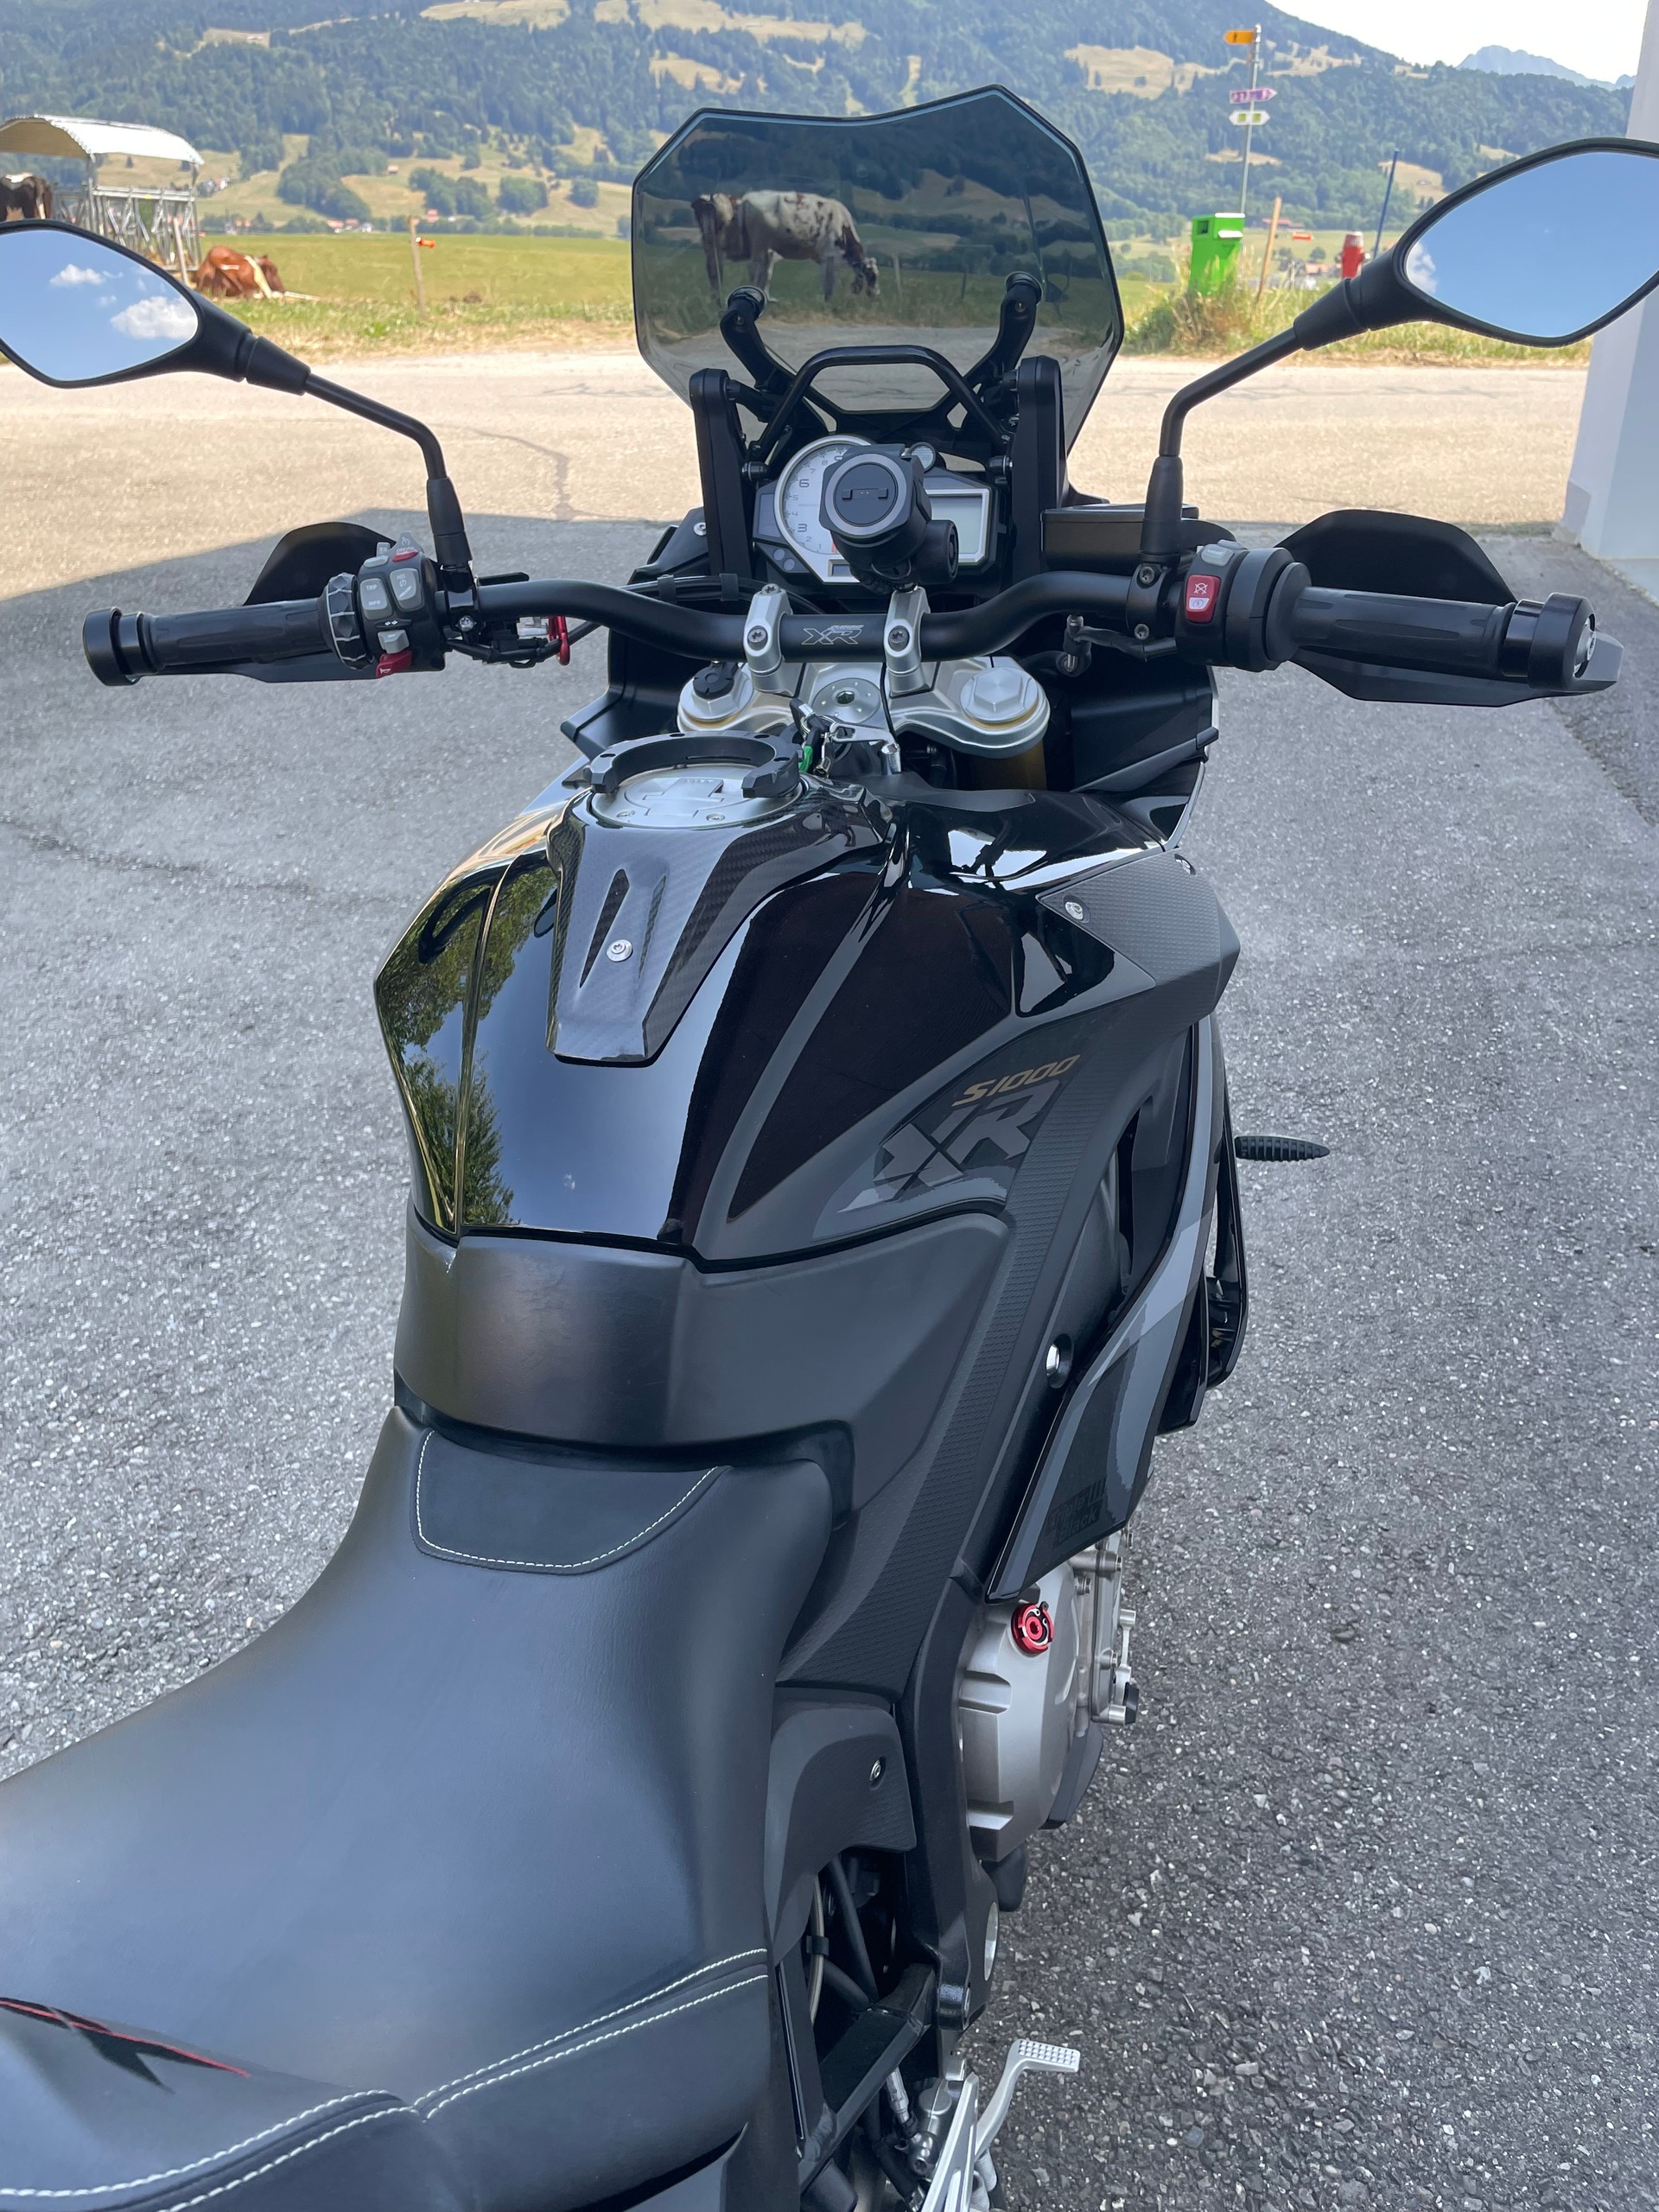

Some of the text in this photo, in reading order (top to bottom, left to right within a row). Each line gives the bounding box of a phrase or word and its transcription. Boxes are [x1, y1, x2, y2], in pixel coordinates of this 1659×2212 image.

[799, 479, 810, 488] 6
[798, 523, 808, 532] 3
[801, 626, 863, 645] XR
[951, 1054, 1080, 1107] S1000
[873, 1079, 1059, 1189] XR
[1057, 1508, 1096, 1541] Black
